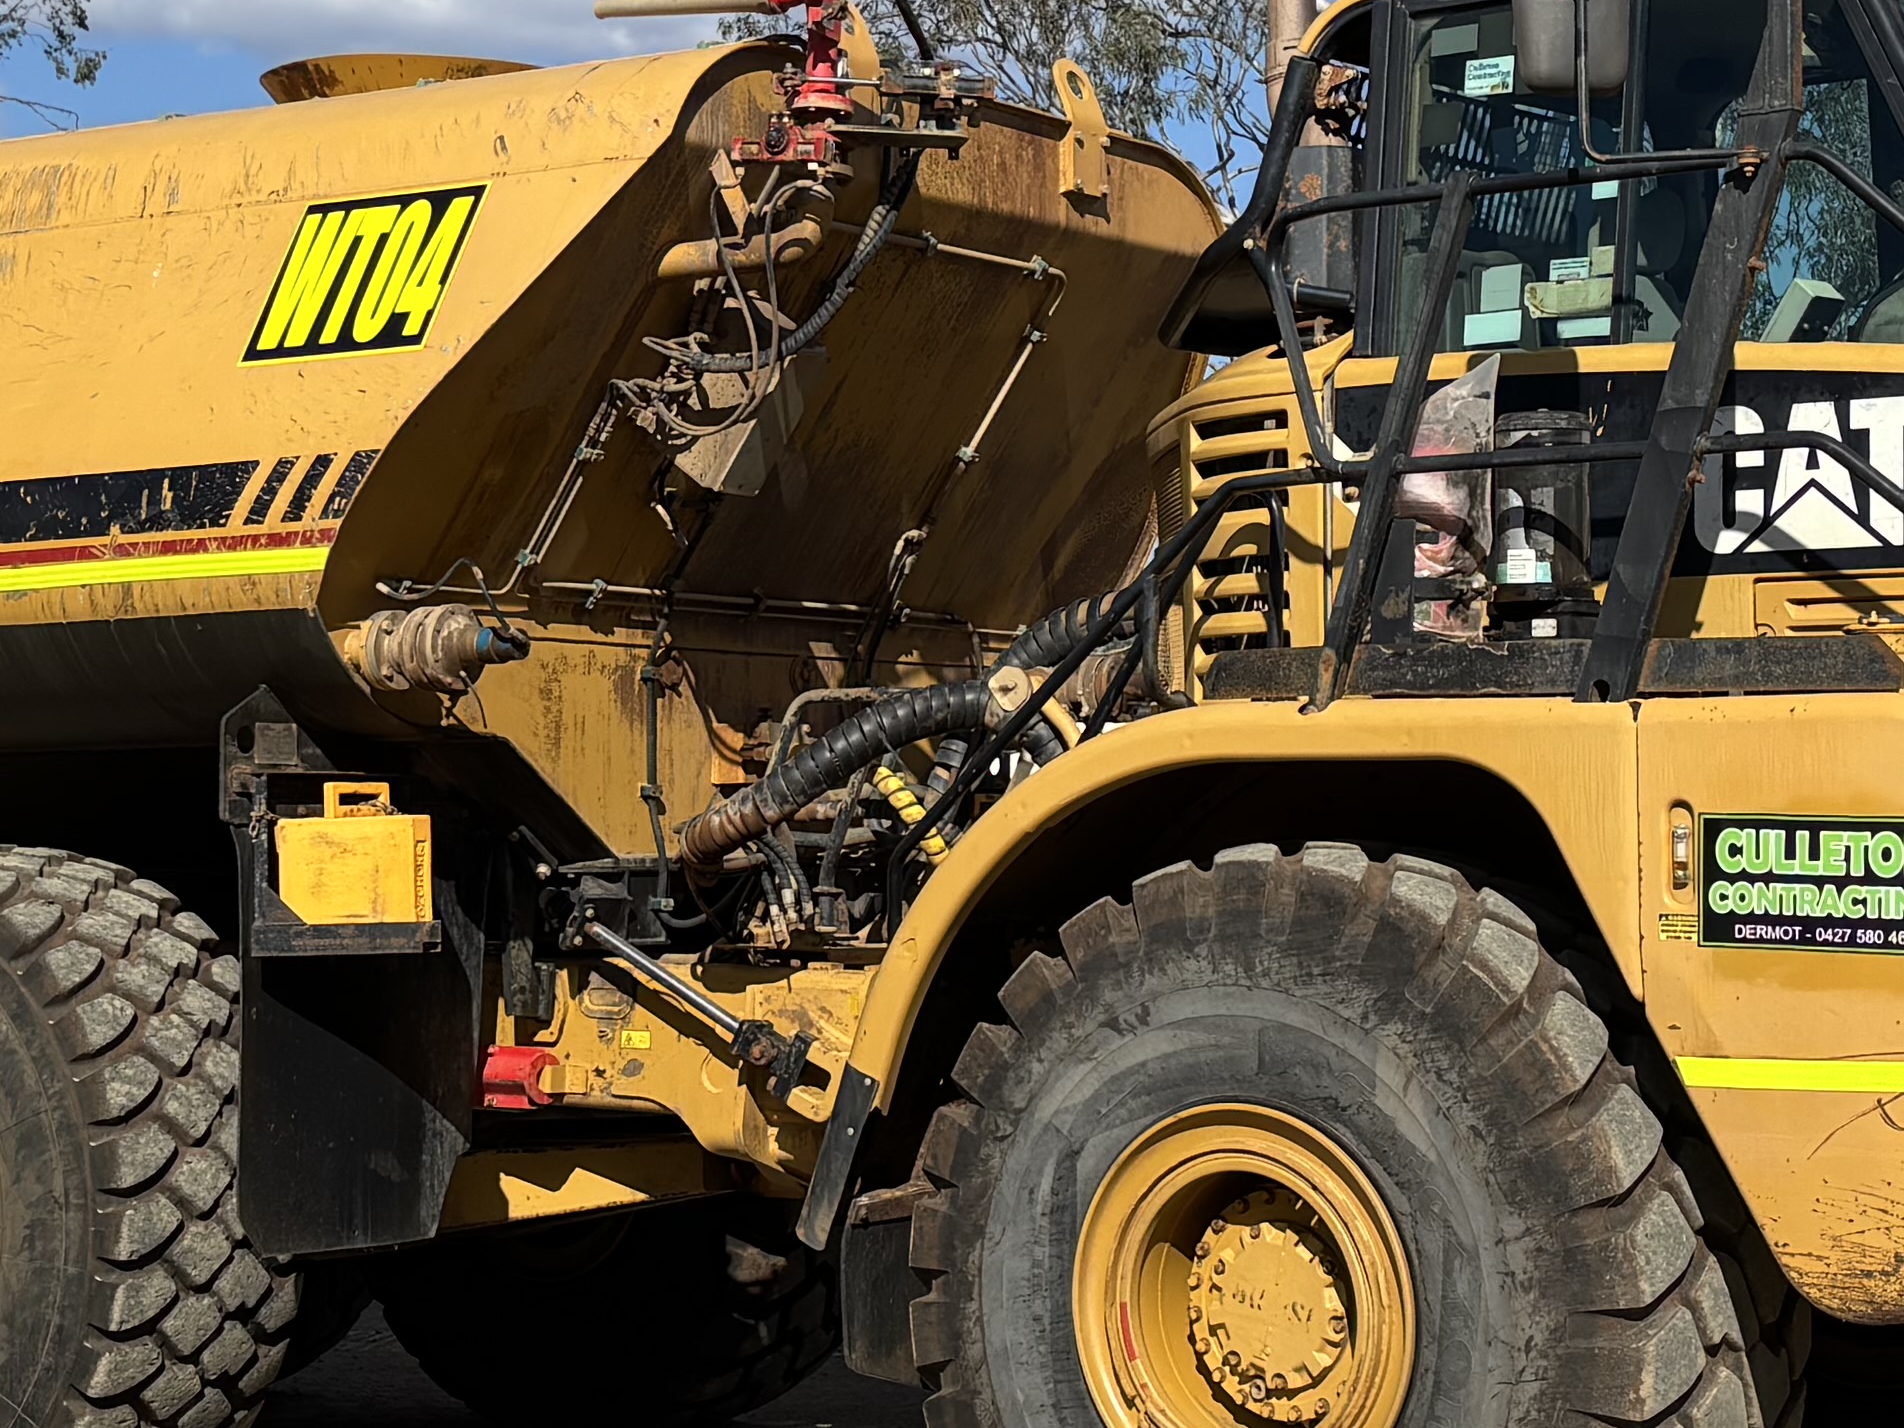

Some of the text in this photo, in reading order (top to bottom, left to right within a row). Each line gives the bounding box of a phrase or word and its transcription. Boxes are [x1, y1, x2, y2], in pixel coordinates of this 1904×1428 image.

[256, 195, 475, 351] WT04
[1734, 924, 1802, 940] DERMOT
[1816, 927, 1851, 943] 0427
[1856, 930, 1884, 944] 580
